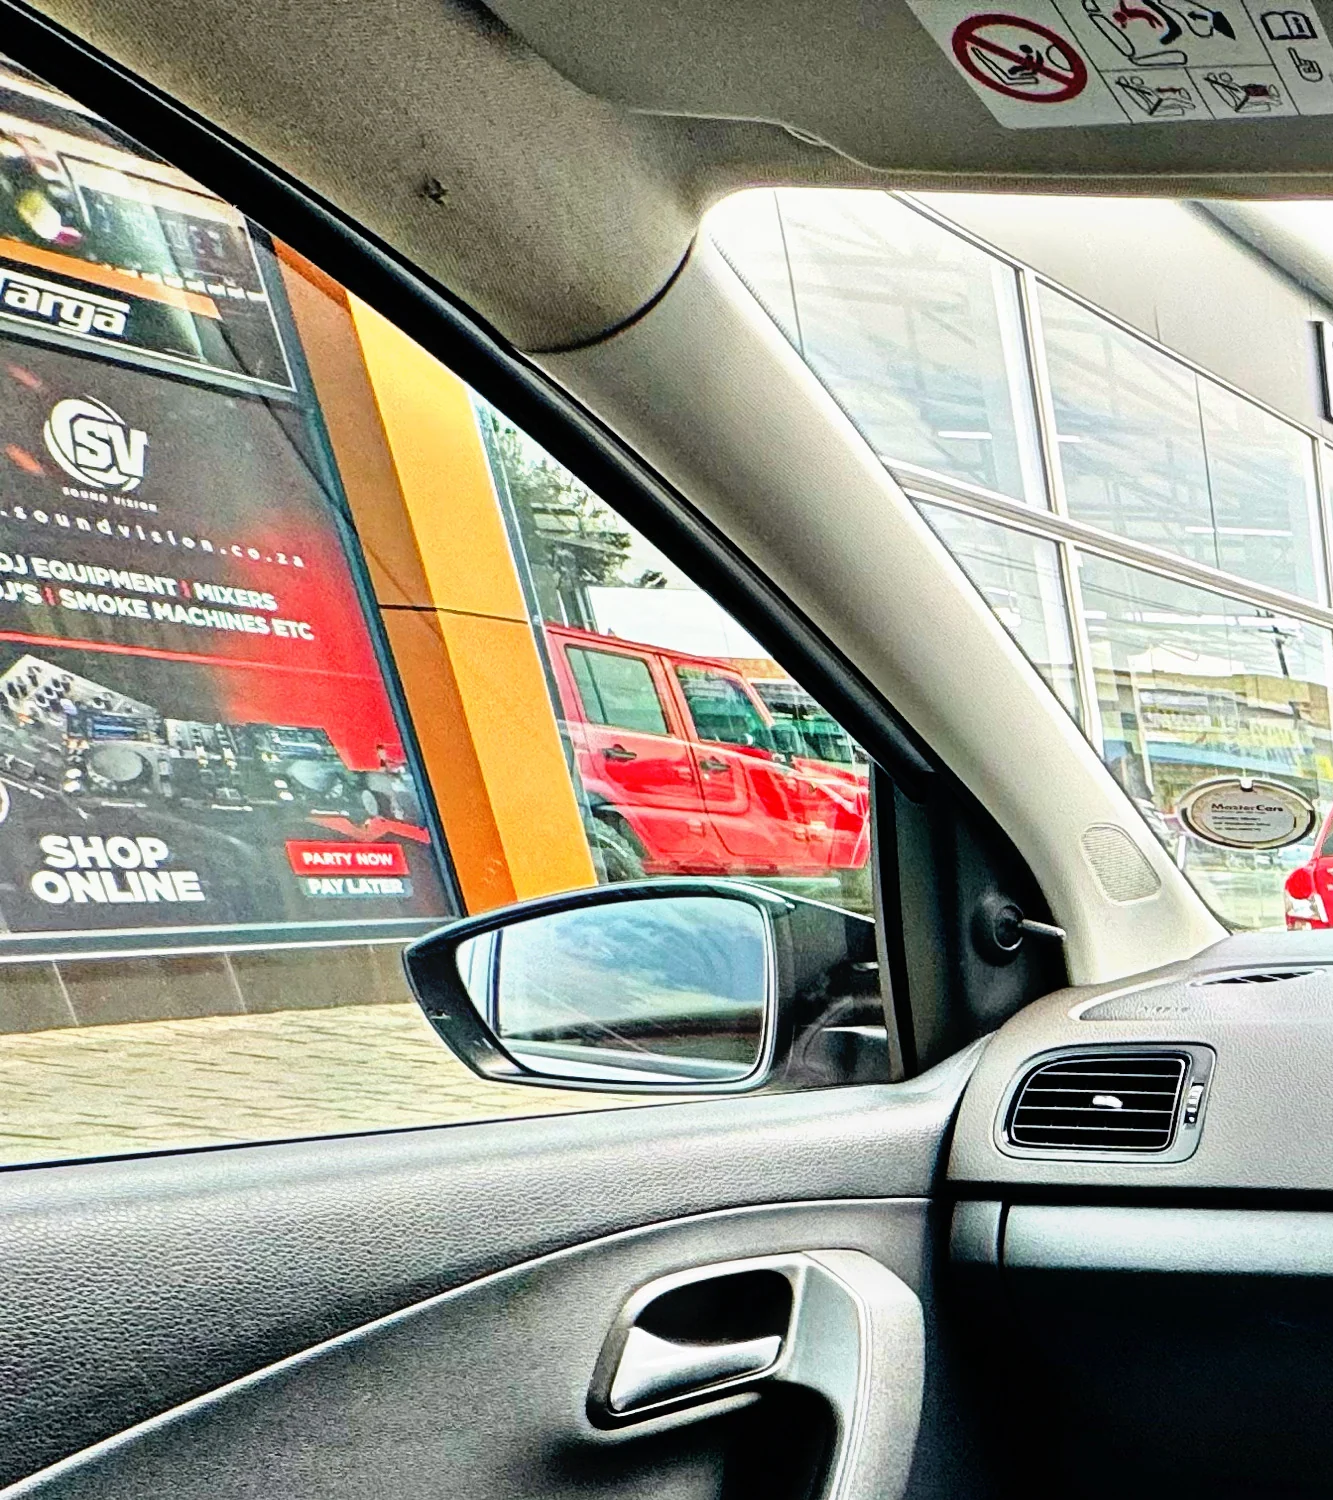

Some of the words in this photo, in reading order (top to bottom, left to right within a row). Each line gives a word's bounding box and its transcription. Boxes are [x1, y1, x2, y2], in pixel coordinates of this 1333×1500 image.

[0, 268, 131, 335] arga
[30, 556, 177, 597] EQUIPMENT
[193, 582, 278, 611] MIXERS
[58, 588, 150, 619] SMOKE
[152, 601, 271, 635] MACHINES
[271, 618, 315, 641] ETC
[39, 835, 169, 869] SHOP
[302, 851, 352, 866] PARTY
[354, 853, 393, 866] NOW
[31, 870, 205, 904] ONLINE
[308, 878, 345, 895] PAY
[345, 878, 404, 894] LATER
